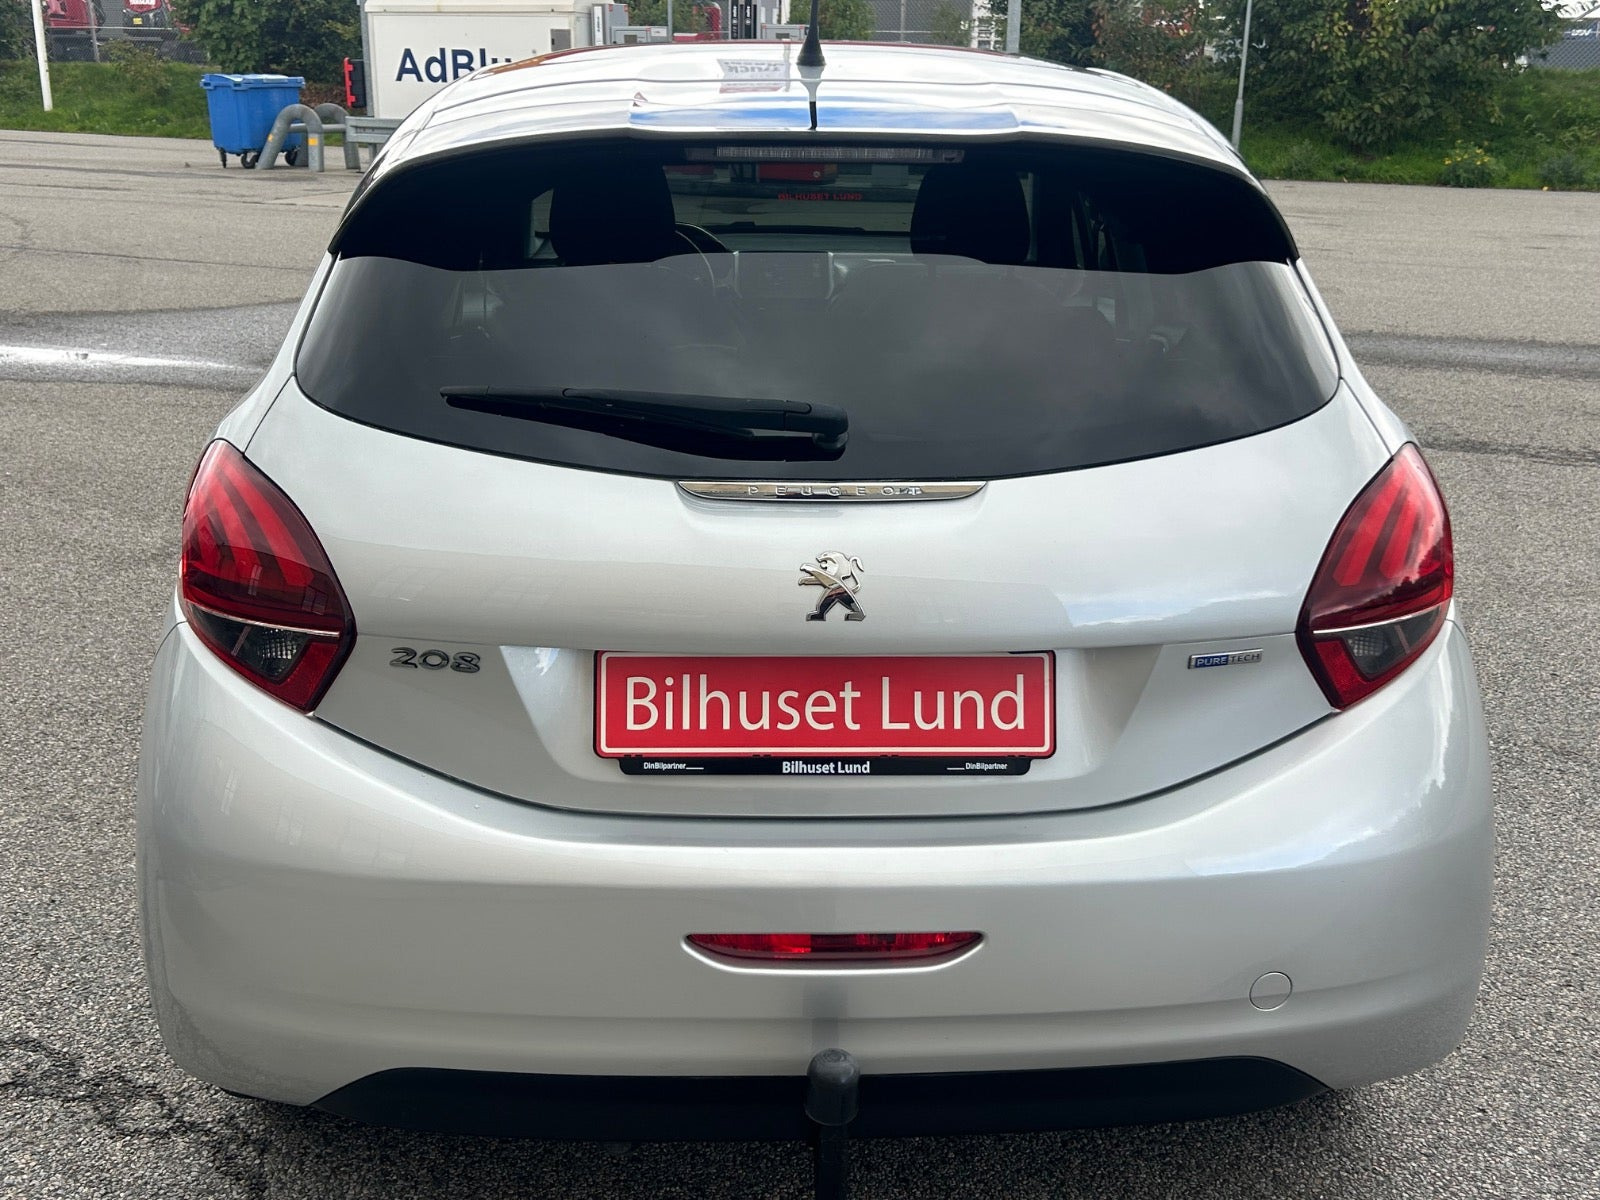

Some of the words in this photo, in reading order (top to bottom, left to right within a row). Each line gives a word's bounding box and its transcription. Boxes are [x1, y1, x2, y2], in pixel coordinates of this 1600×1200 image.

[395, 48, 511, 83] AdBl
[747, 486, 922, 496] PEUGEOT
[389, 647, 481, 673] 208
[625, 674, 861, 731] Bilhuset
[881, 674, 1025, 731] Lund
[782, 761, 835, 774] Bilhuset
[837, 761, 870, 773] Lund
